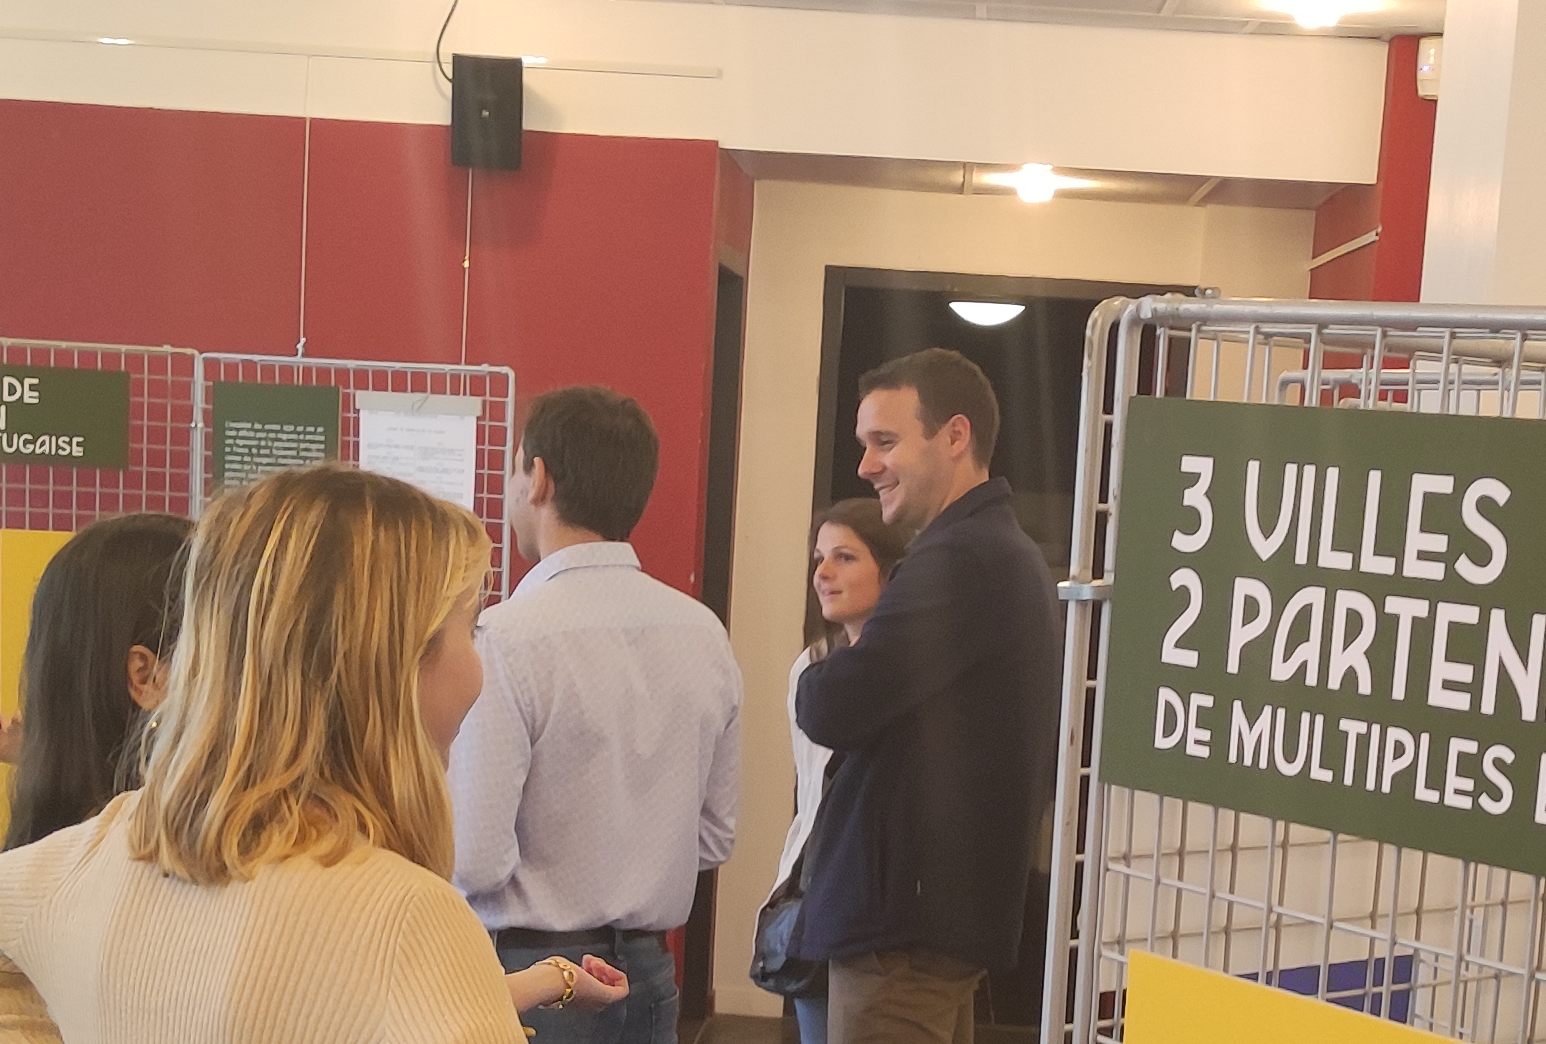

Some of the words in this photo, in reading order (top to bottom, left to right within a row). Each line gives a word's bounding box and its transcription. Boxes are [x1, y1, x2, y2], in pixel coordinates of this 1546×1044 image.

[2, 376, 40, 404] DE
[1170, 453, 1215, 554] 3
[1243, 458, 1513, 586] VILLES
[1159, 566, 1204, 669] 2
[1152, 685, 1215, 760] DE
[1227, 698, 1517, 829] MULTIPLES
